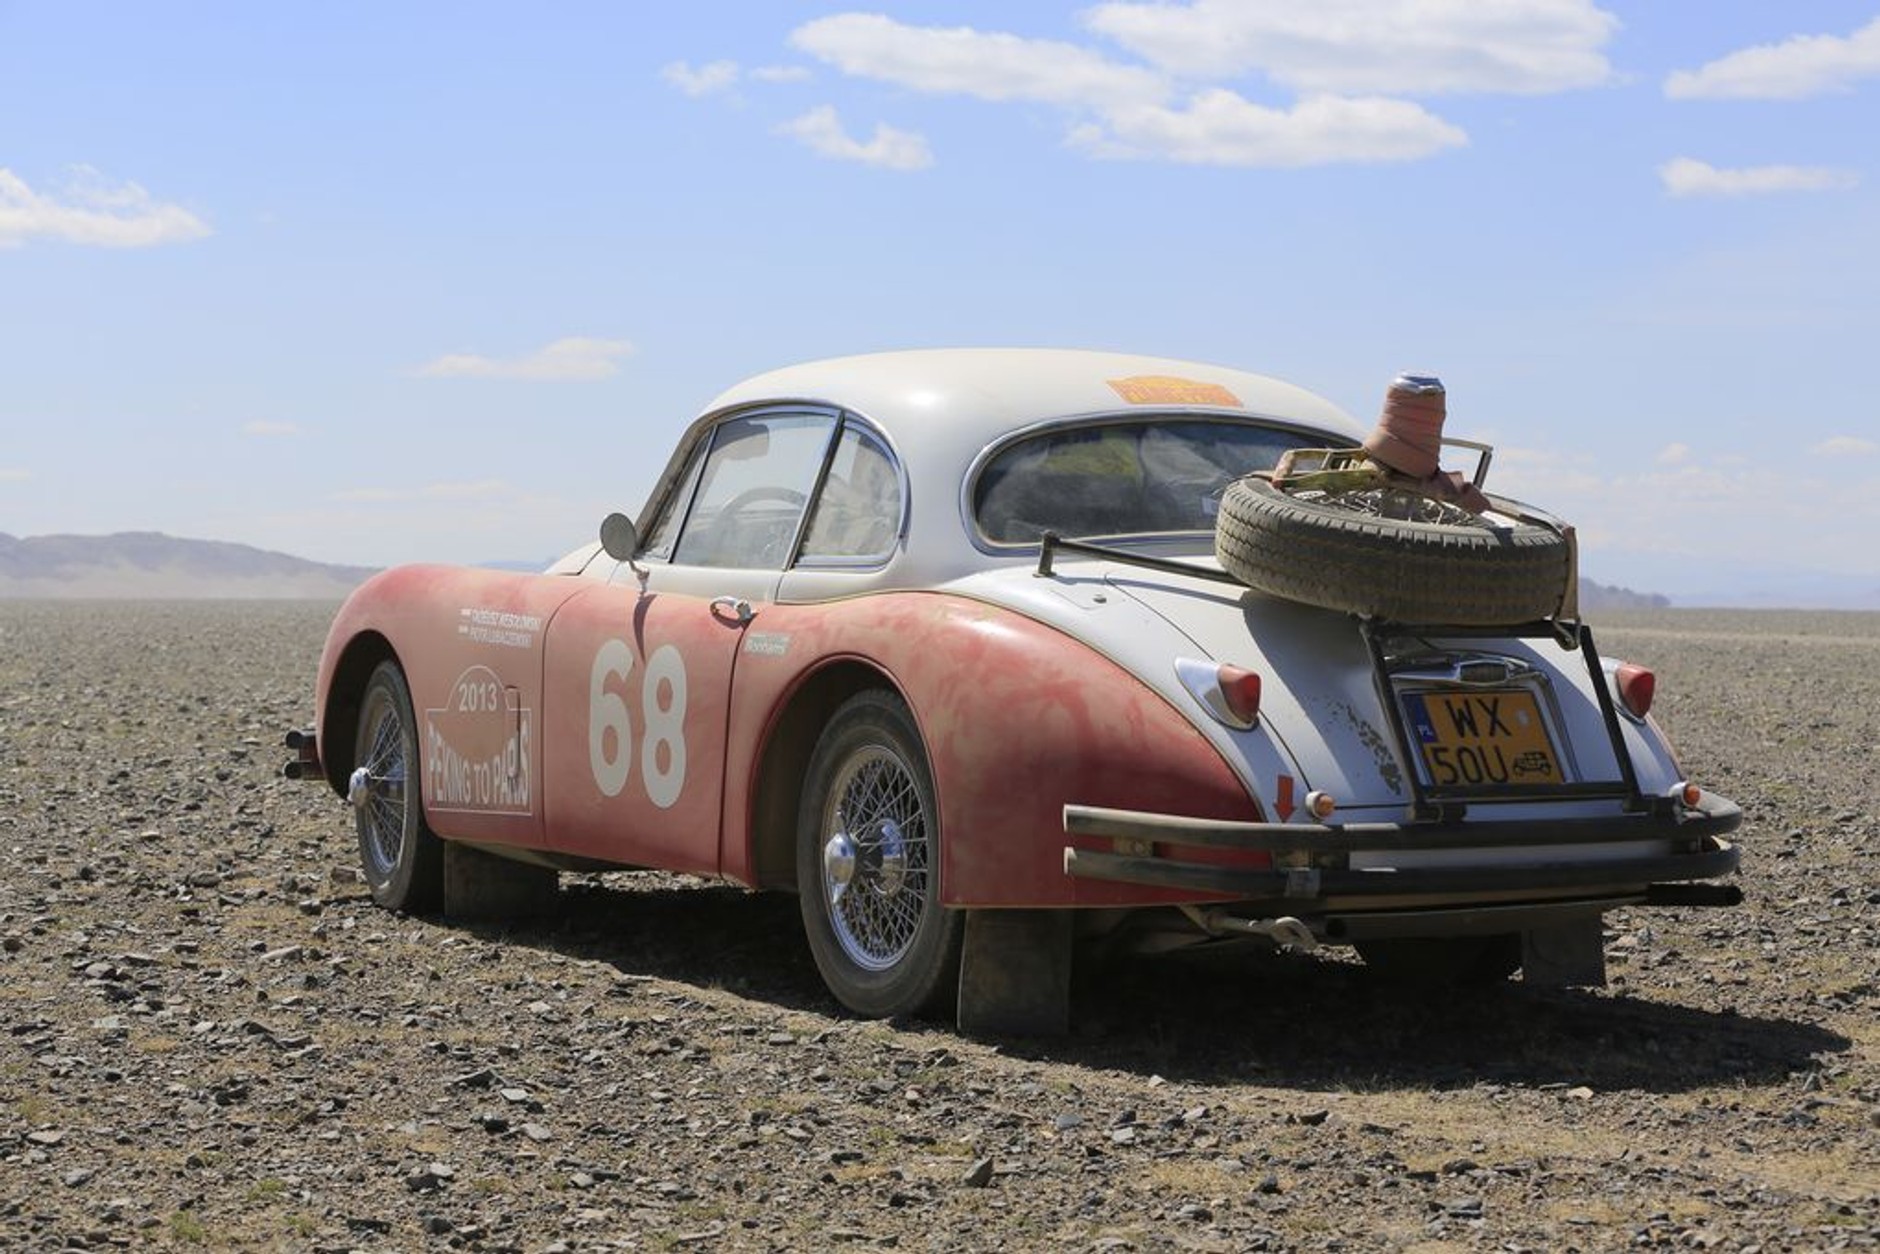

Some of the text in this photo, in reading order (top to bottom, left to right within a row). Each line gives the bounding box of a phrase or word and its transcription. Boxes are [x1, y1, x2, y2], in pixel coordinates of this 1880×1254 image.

[458, 682, 498, 712] 2013
[589, 638, 688, 809] 68
[1444, 698, 1512, 738] WX
[428, 719, 471, 804] PEKING
[473, 762, 490, 805] TO
